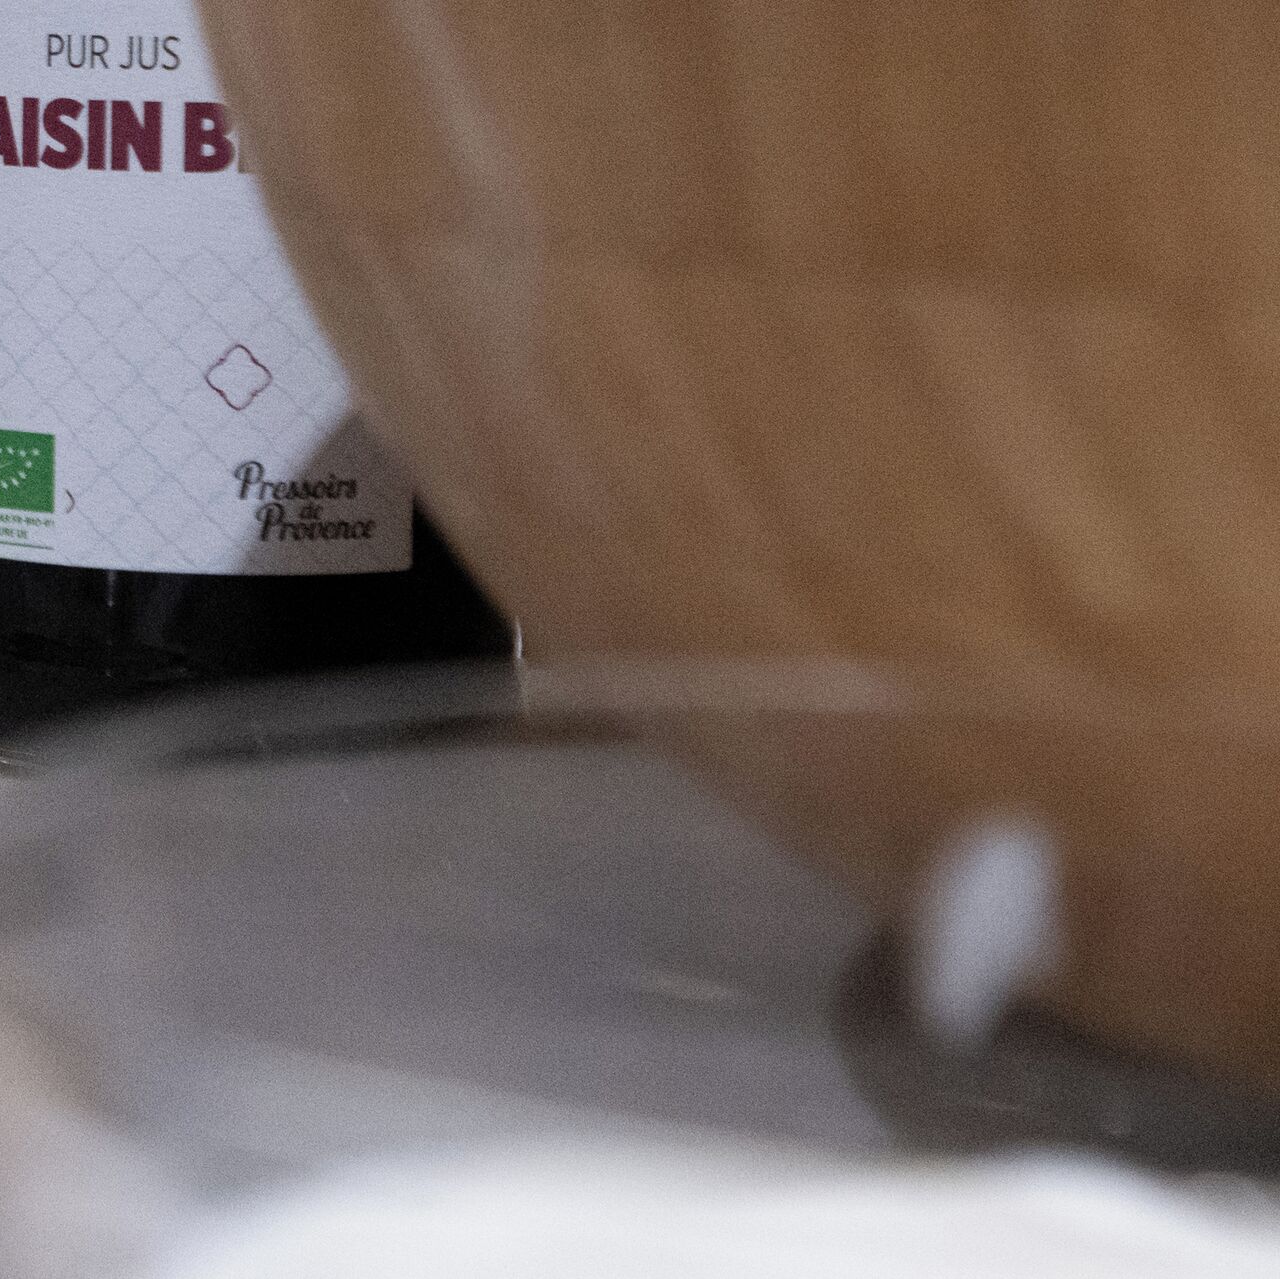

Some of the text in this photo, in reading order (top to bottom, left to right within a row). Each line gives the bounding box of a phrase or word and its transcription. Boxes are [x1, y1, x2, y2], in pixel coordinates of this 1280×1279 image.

[46, 33, 181, 71] PUR JUS
[183, 101, 242, 173] B
[234, 460, 358, 500] Pressoirs
[255, 502, 377, 542] Provence
